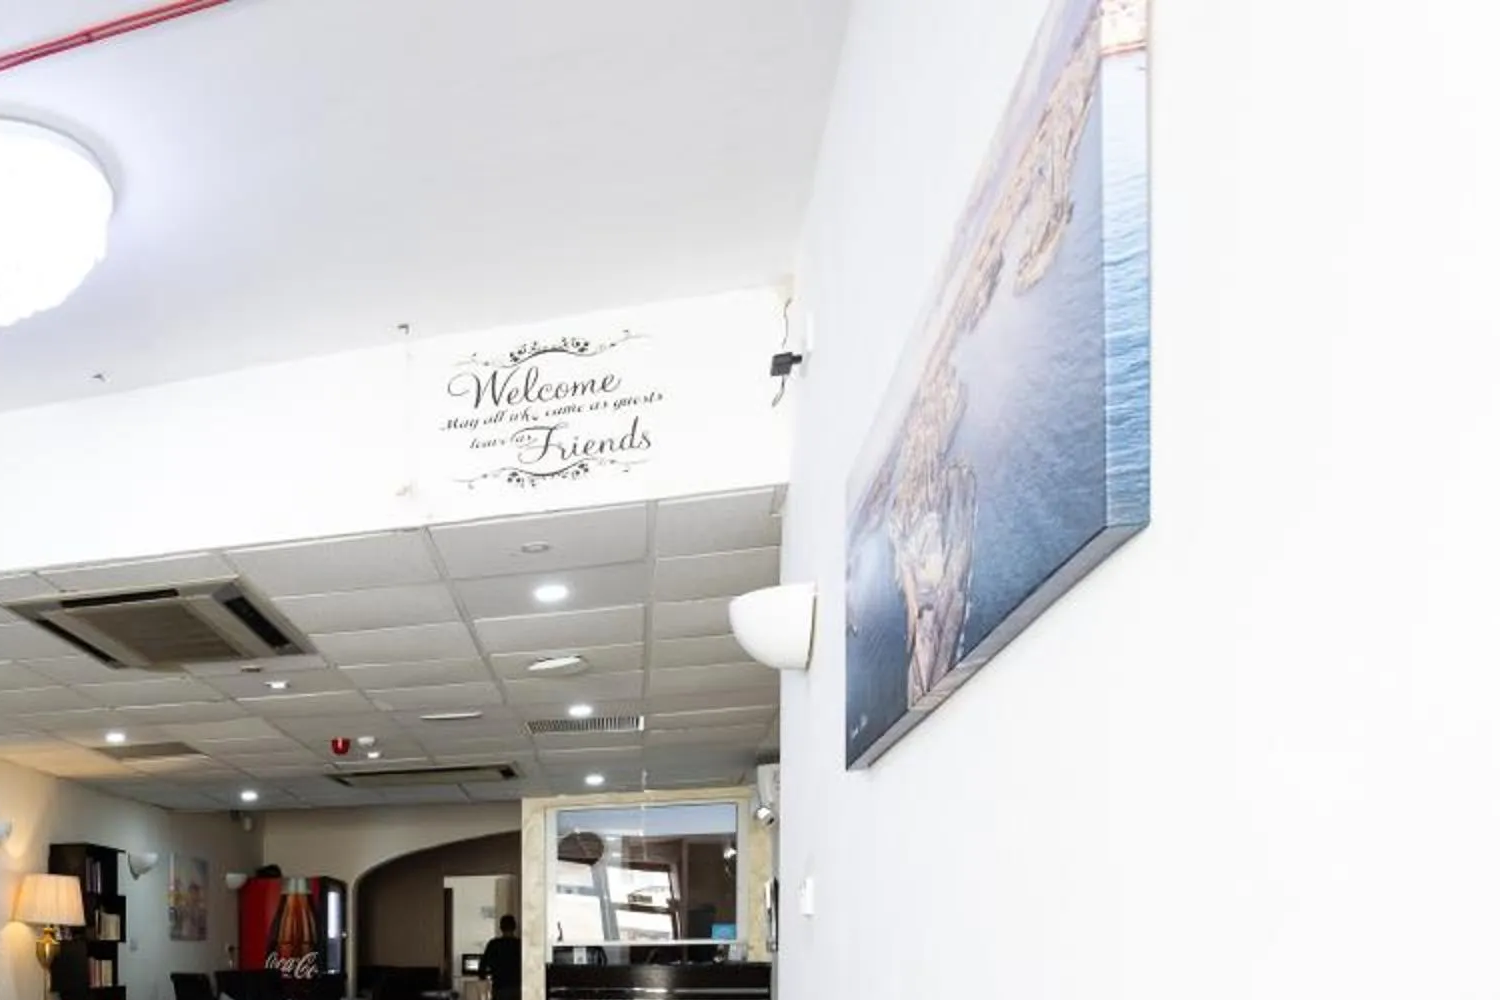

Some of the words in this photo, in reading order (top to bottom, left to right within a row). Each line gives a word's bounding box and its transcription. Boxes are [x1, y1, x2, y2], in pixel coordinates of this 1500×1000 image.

[447, 365, 622, 409] Welcome
[439, 418, 479, 432] May
[483, 409, 506, 426] all
[545, 403, 584, 417] came
[589, 400, 609, 412] as
[612, 391, 664, 411] guests
[510, 416, 652, 464] Friends
